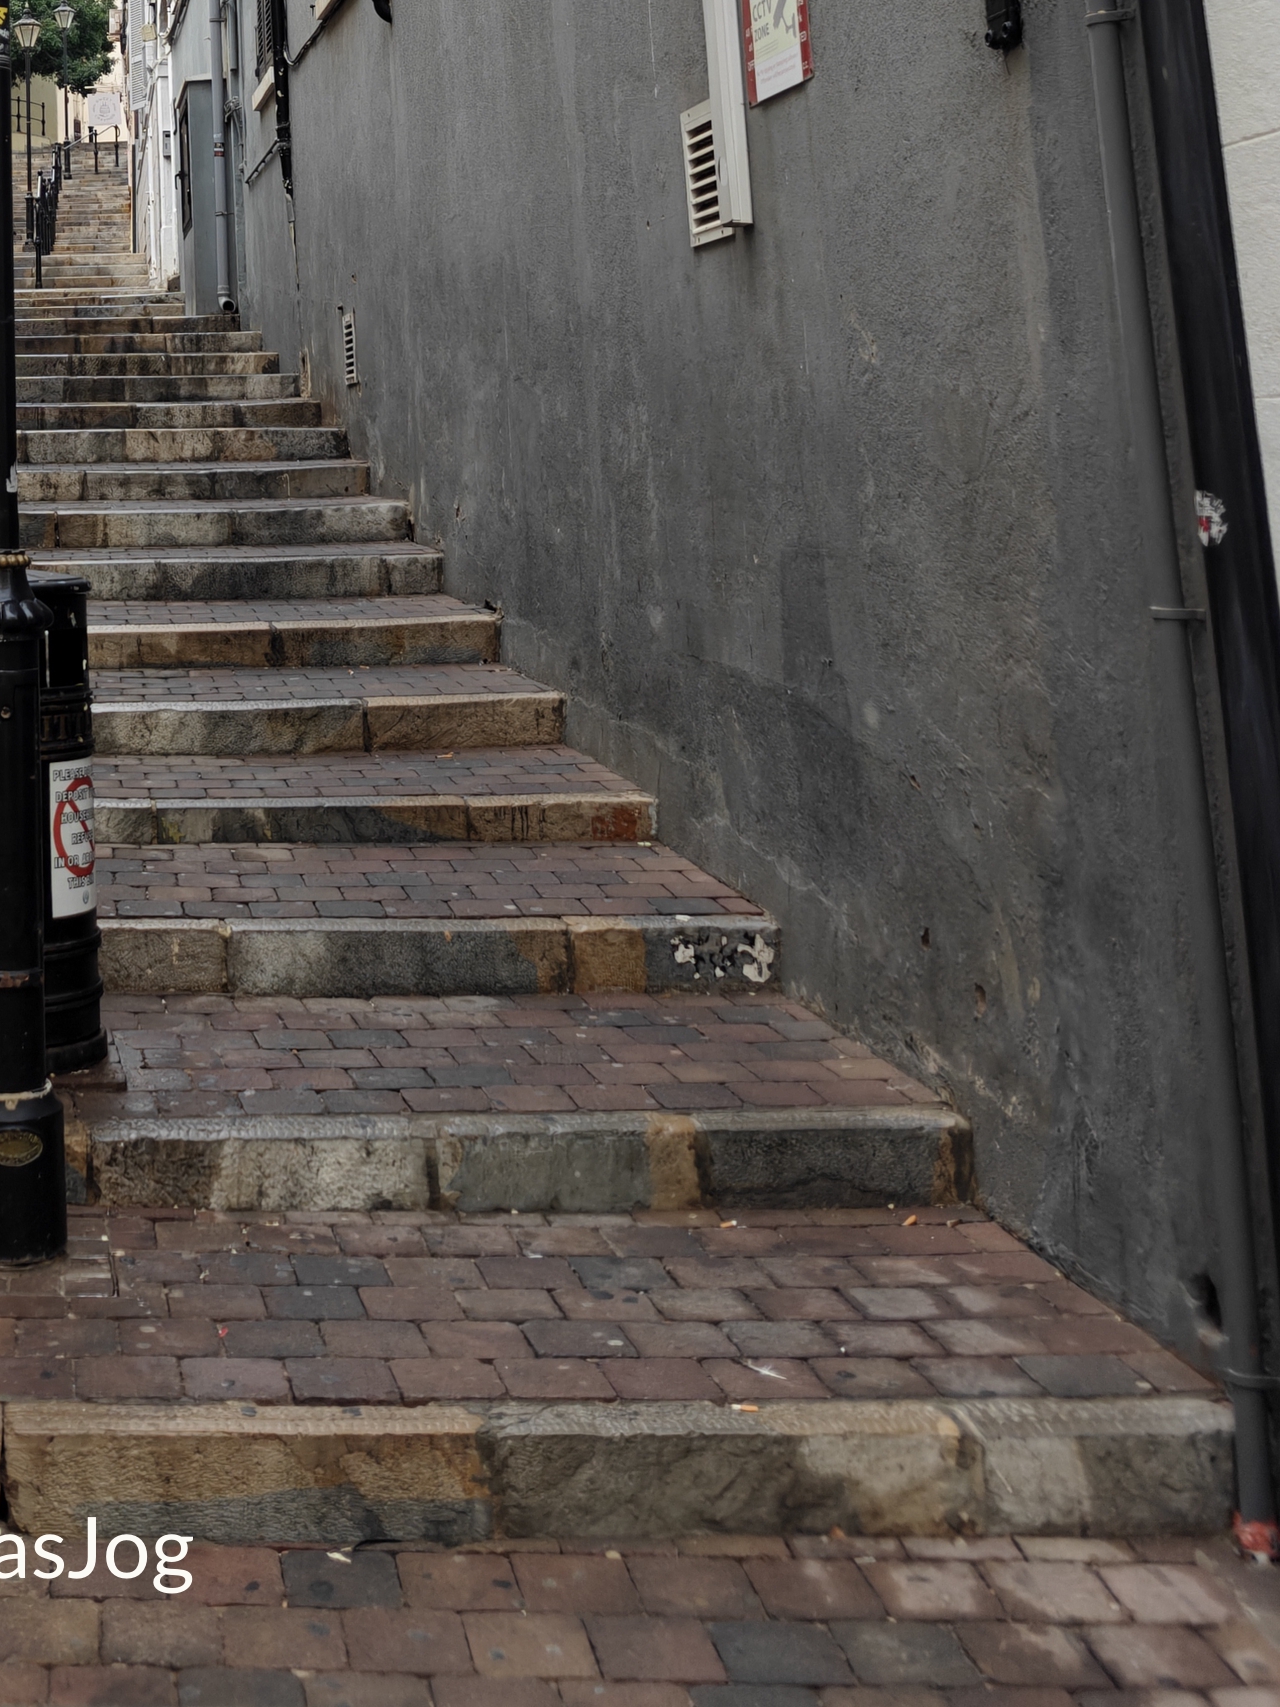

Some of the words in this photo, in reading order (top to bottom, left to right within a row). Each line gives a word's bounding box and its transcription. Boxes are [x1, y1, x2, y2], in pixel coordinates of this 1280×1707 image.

[754, 22, 770, 43] ZONE
[53, 767, 84, 782] PLEASE
[54, 856, 65, 869] IN
[67, 854, 80, 867] OR
